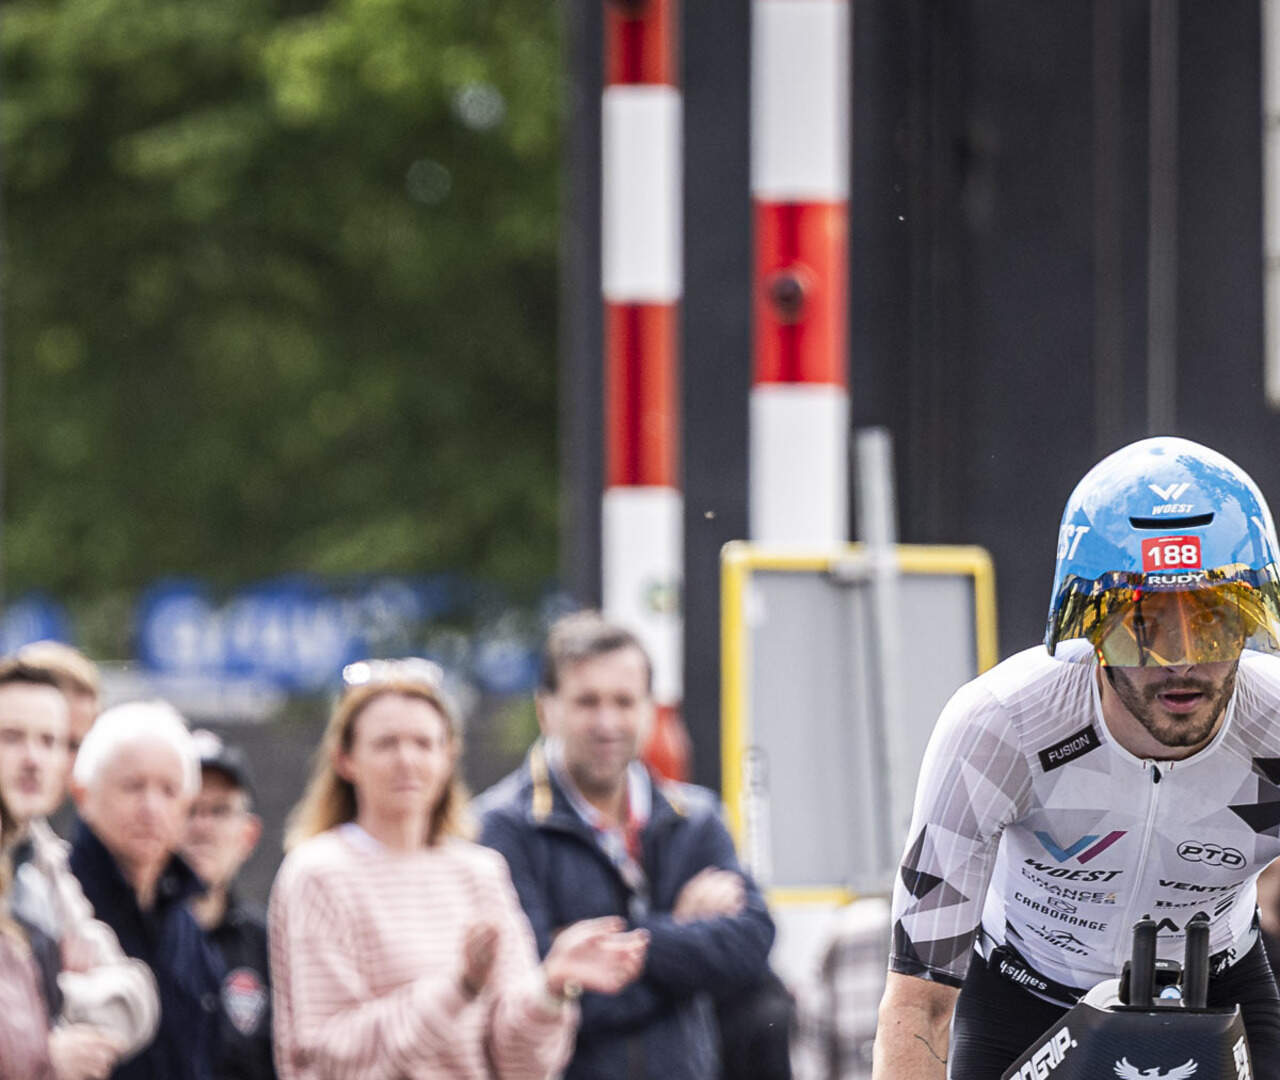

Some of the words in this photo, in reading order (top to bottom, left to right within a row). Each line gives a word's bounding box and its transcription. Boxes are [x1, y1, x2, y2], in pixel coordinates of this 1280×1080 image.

[1151, 504, 1194, 515] WOEST
[1147, 544, 1198, 567] 188
[1148, 574, 1204, 585] RUDY
[1048, 734, 1090, 763] FUSION
[1181, 845, 1242, 865] PTO
[1024, 858, 1124, 882] WOEST
[1014, 891, 1108, 932] CARBORANGE
[1000, 960, 1048, 990] sailfish
